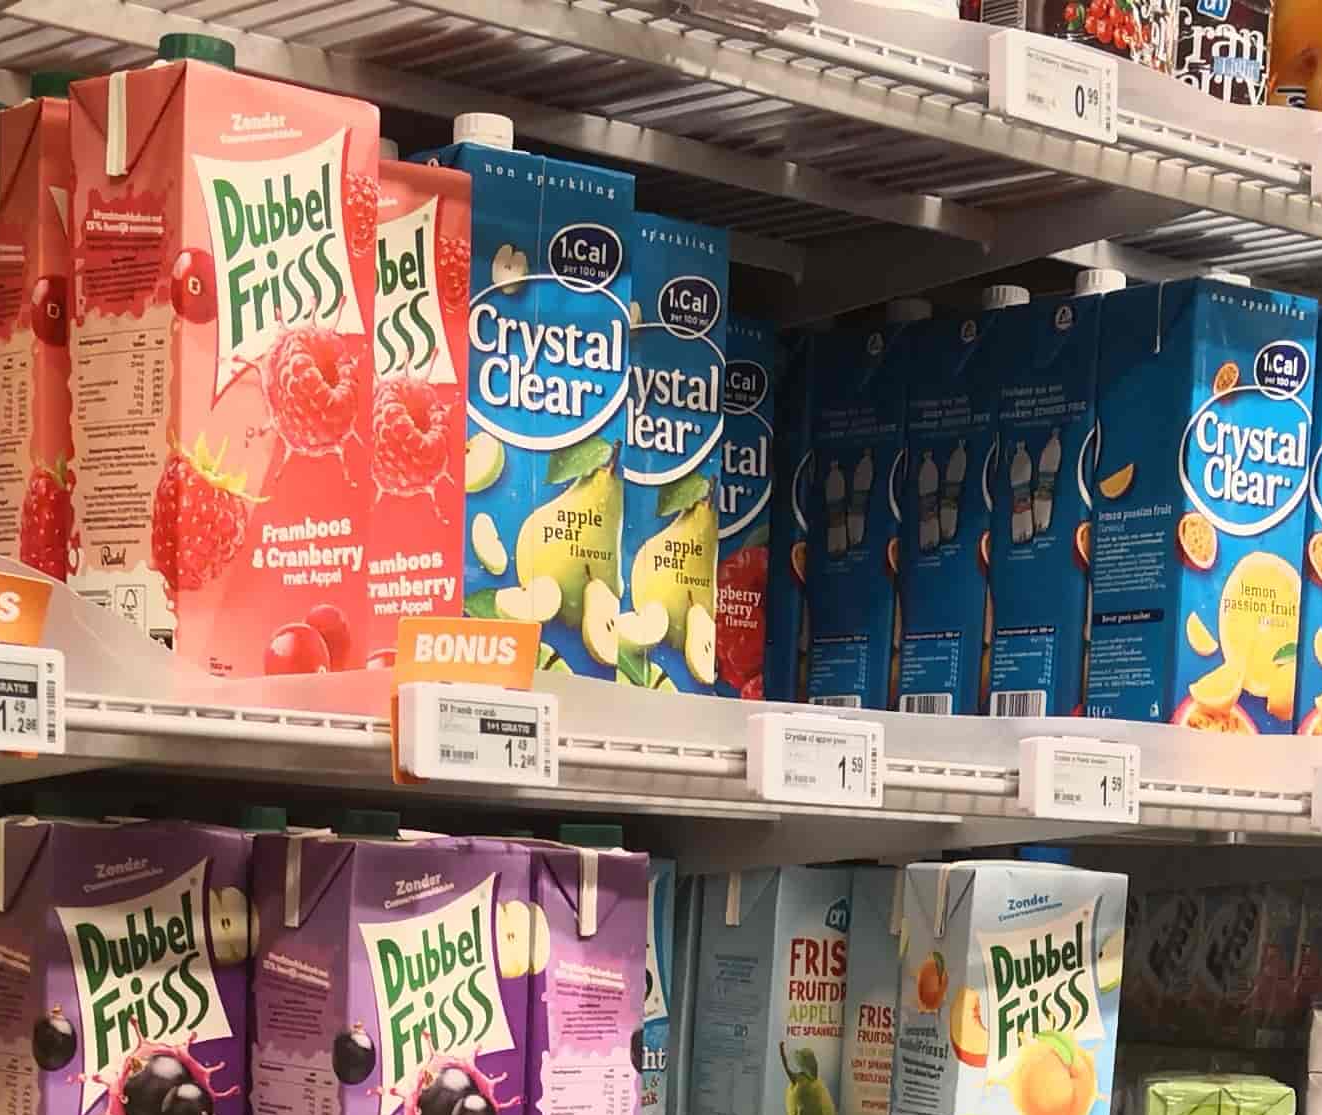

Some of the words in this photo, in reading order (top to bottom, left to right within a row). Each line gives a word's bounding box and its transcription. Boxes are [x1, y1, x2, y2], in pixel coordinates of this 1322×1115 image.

[484, 162, 517, 178] non
[212, 162, 333, 262] Dubbel
[468, 303, 623, 375] Crystal
[478, 357, 598, 420] Clear
[1196, 410, 1307, 478] Crystal
[1203, 462, 1280, 507] Clear
[261, 516, 352, 544] Framboos
[556, 505, 603, 530] apple
[543, 522, 582, 543] pear
[266, 541, 365, 574] Cranberry
[569, 545, 614, 562] flavour
[653, 551, 688, 571] pear
[664, 538, 703, 562] apple
[283, 570, 306, 587] met
[307, 566, 342, 587] Appel
[1240, 581, 1277, 599] lemon
[373, 601, 398, 616] met
[400, 598, 433, 617] Appel
[1223, 598, 1267, 613] passion
[1270, 600, 1297, 617] fruit
[415, 634, 518, 665] BONUS
[77, 891, 196, 995] Dubbel
[377, 905, 483, 1009] Dubbel
[991, 921, 1084, 998] Dubbel
